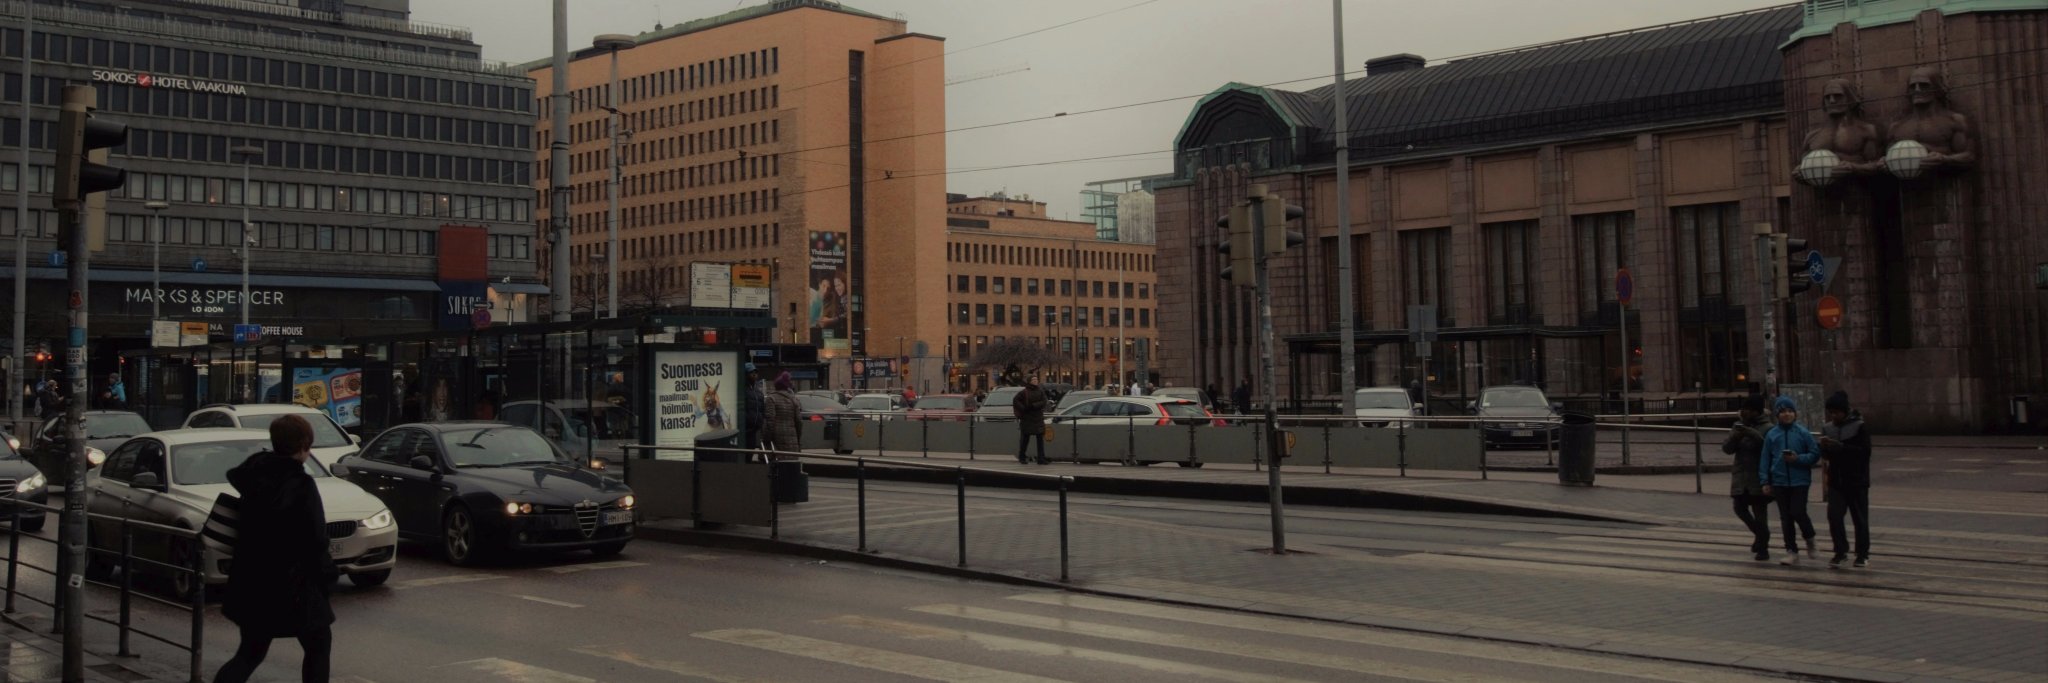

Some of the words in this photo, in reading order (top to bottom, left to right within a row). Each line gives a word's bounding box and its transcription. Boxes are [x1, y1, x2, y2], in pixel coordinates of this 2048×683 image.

[92, 69, 137, 85] SOKOS
[152, 76, 191, 90] HOTEL
[192, 80, 247, 96] VAAKUNA
[126, 287, 187, 304] MARKS
[191, 290, 203, 304] &
[260, 325, 281, 335] OFFEE
[281, 326, 304, 336] HOUSE
[661, 362, 723, 379] Suomessa
[675, 379, 699, 391] asuu
[659, 393, 689, 402] maailman
[661, 402, 693, 415] hölmöin
[660, 414, 696, 431] kansa?
